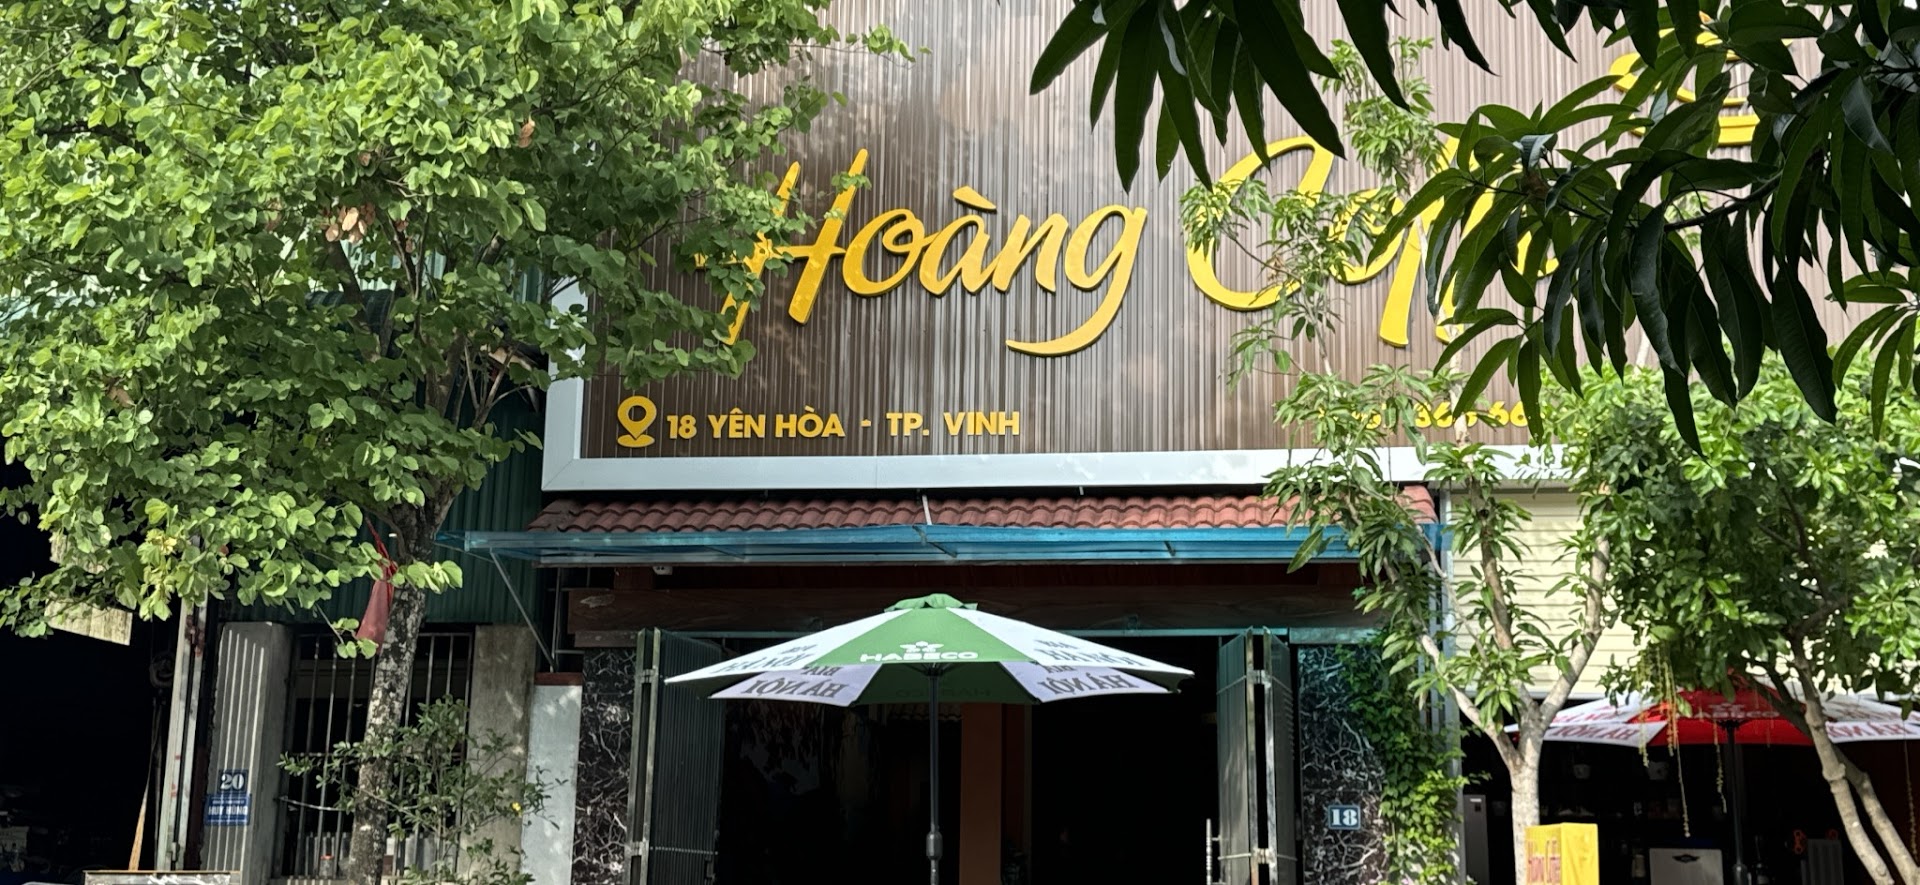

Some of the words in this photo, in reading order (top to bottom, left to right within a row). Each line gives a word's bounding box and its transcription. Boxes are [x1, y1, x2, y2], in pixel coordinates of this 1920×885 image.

[695, 148, 1149, 357] Hoàng
[667, 415, 698, 440] 18
[708, 407, 766, 439] YÊN
[775, 405, 846, 439] HÒA
[886, 412, 930, 436] TP.
[943, 411, 1020, 436] VINH
[860, 651, 979, 662] HABECO
[221, 773, 245, 790] 20
[1332, 809, 1358, 827] 18
